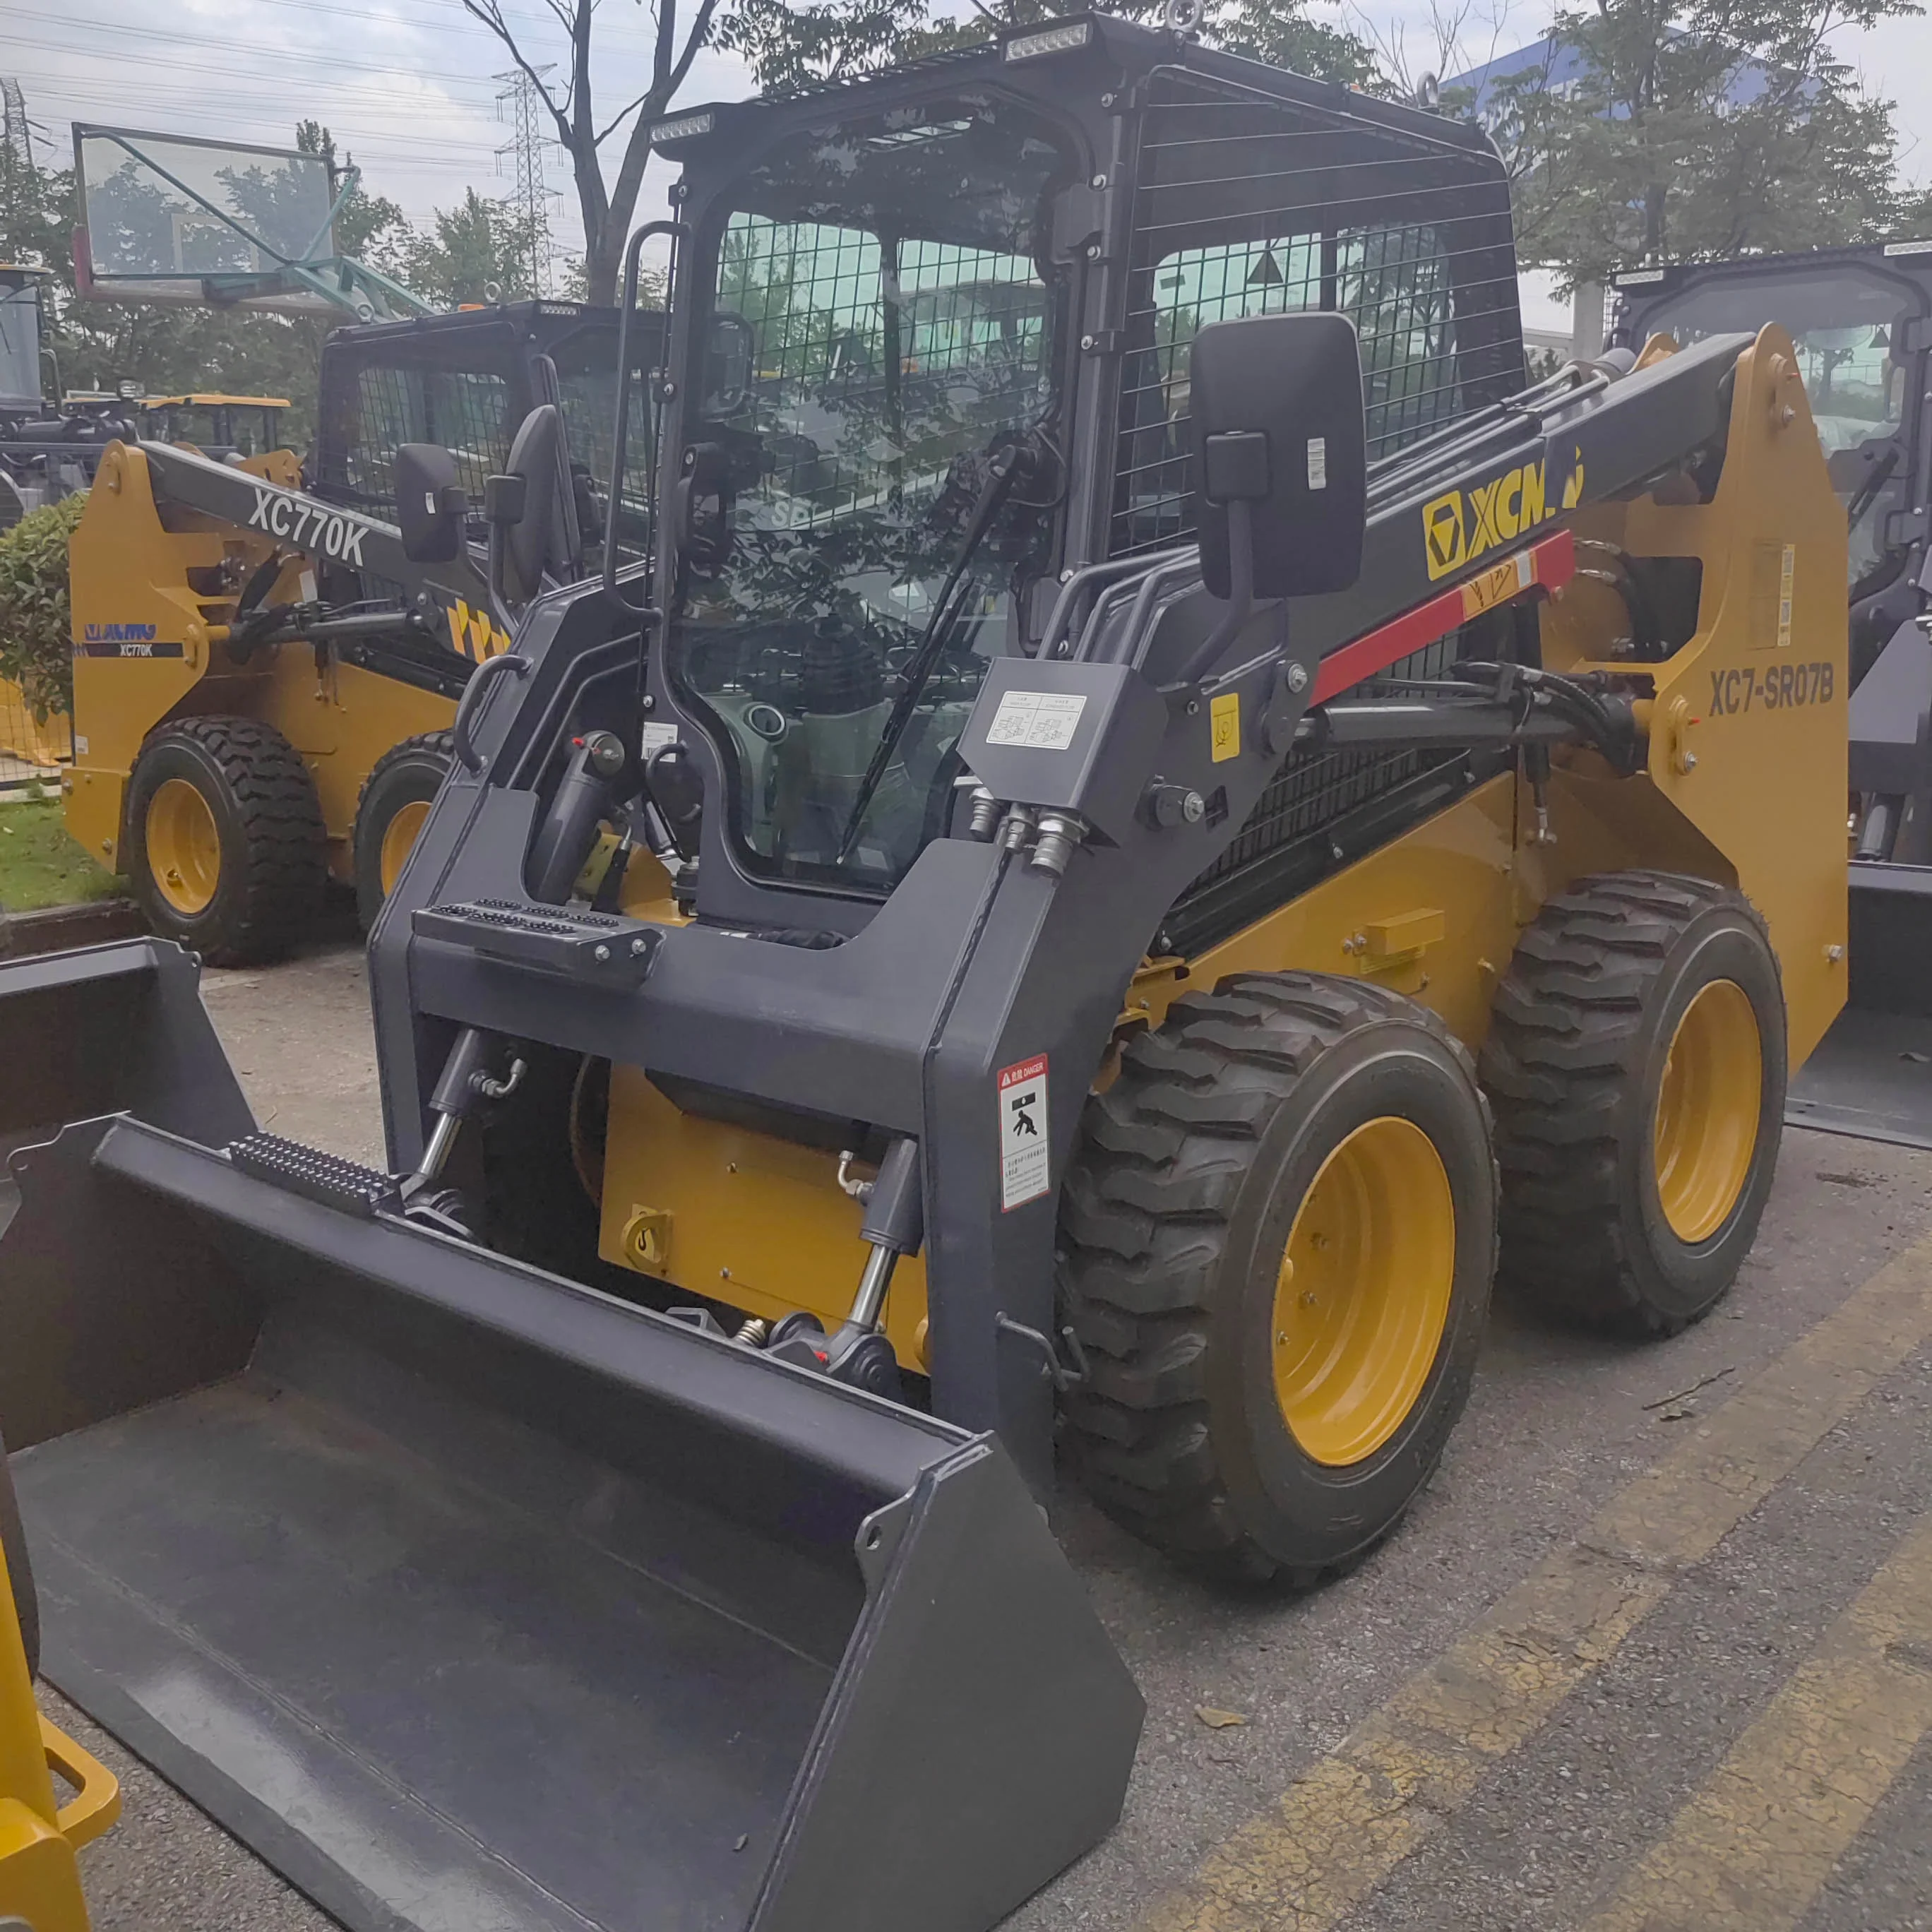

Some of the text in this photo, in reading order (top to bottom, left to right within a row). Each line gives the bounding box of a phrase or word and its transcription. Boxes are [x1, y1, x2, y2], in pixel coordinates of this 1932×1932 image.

[249, 487, 369, 566] XC770K
[120, 643, 153, 657] XC770K
[1709, 662, 1834, 717] XC7-SR07B
[1024, 1062, 1044, 1077] DANGER
